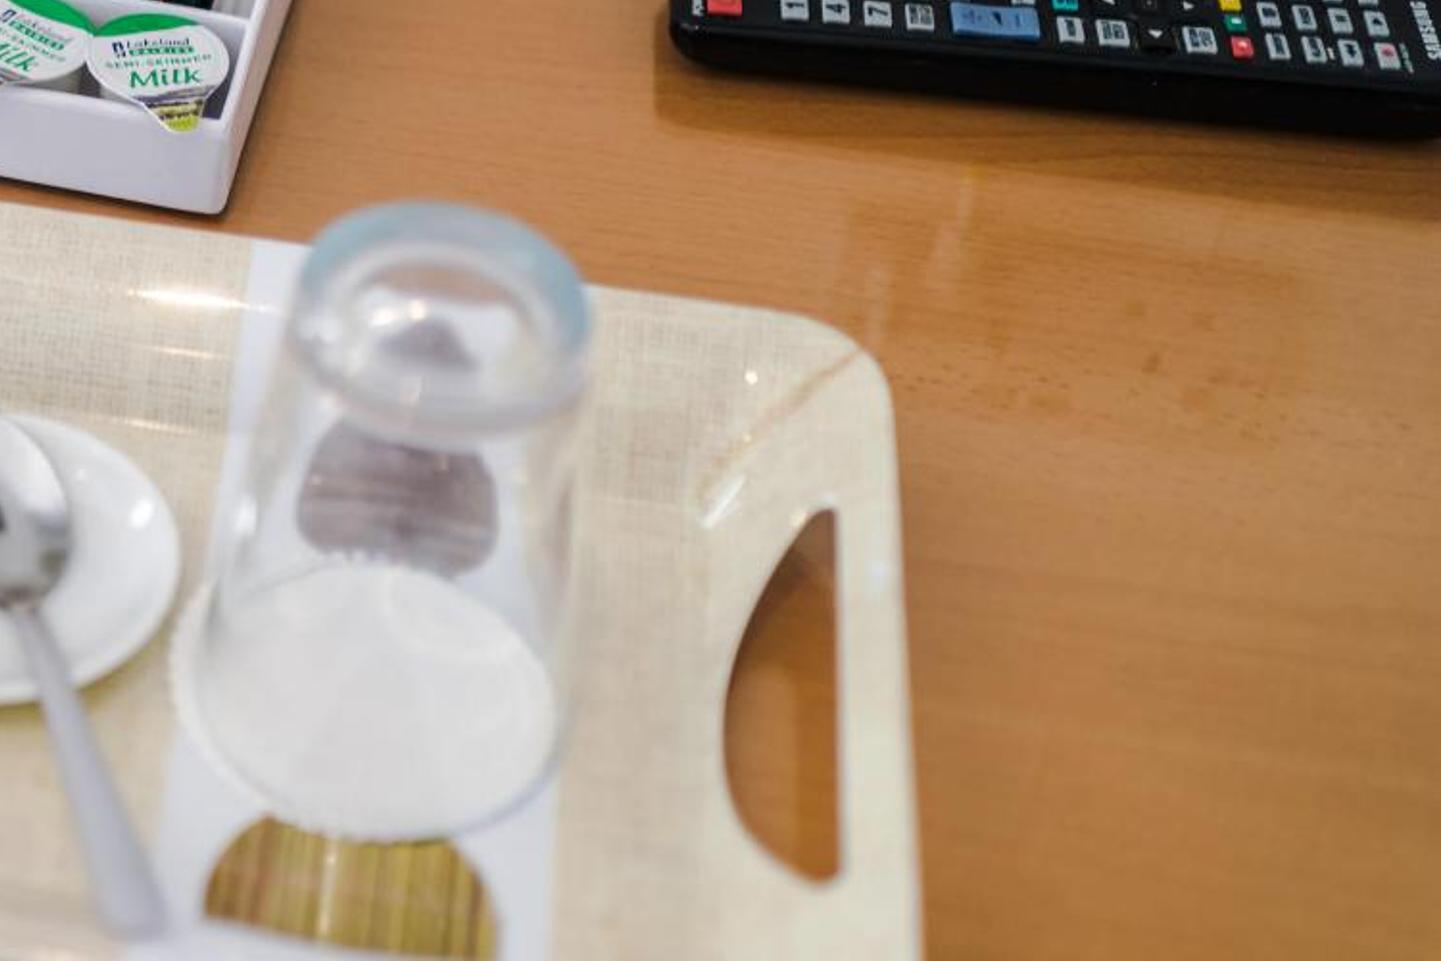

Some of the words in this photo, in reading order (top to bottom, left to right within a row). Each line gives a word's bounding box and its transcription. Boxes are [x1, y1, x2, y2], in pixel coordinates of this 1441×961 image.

[785, 1, 805, 9] 1
[825, 3, 846, 14] 4
[867, 5, 888, 16] 7
[1410, 1, 1441, 59] SAMSUNG
[130, 67, 200, 89] Milk
